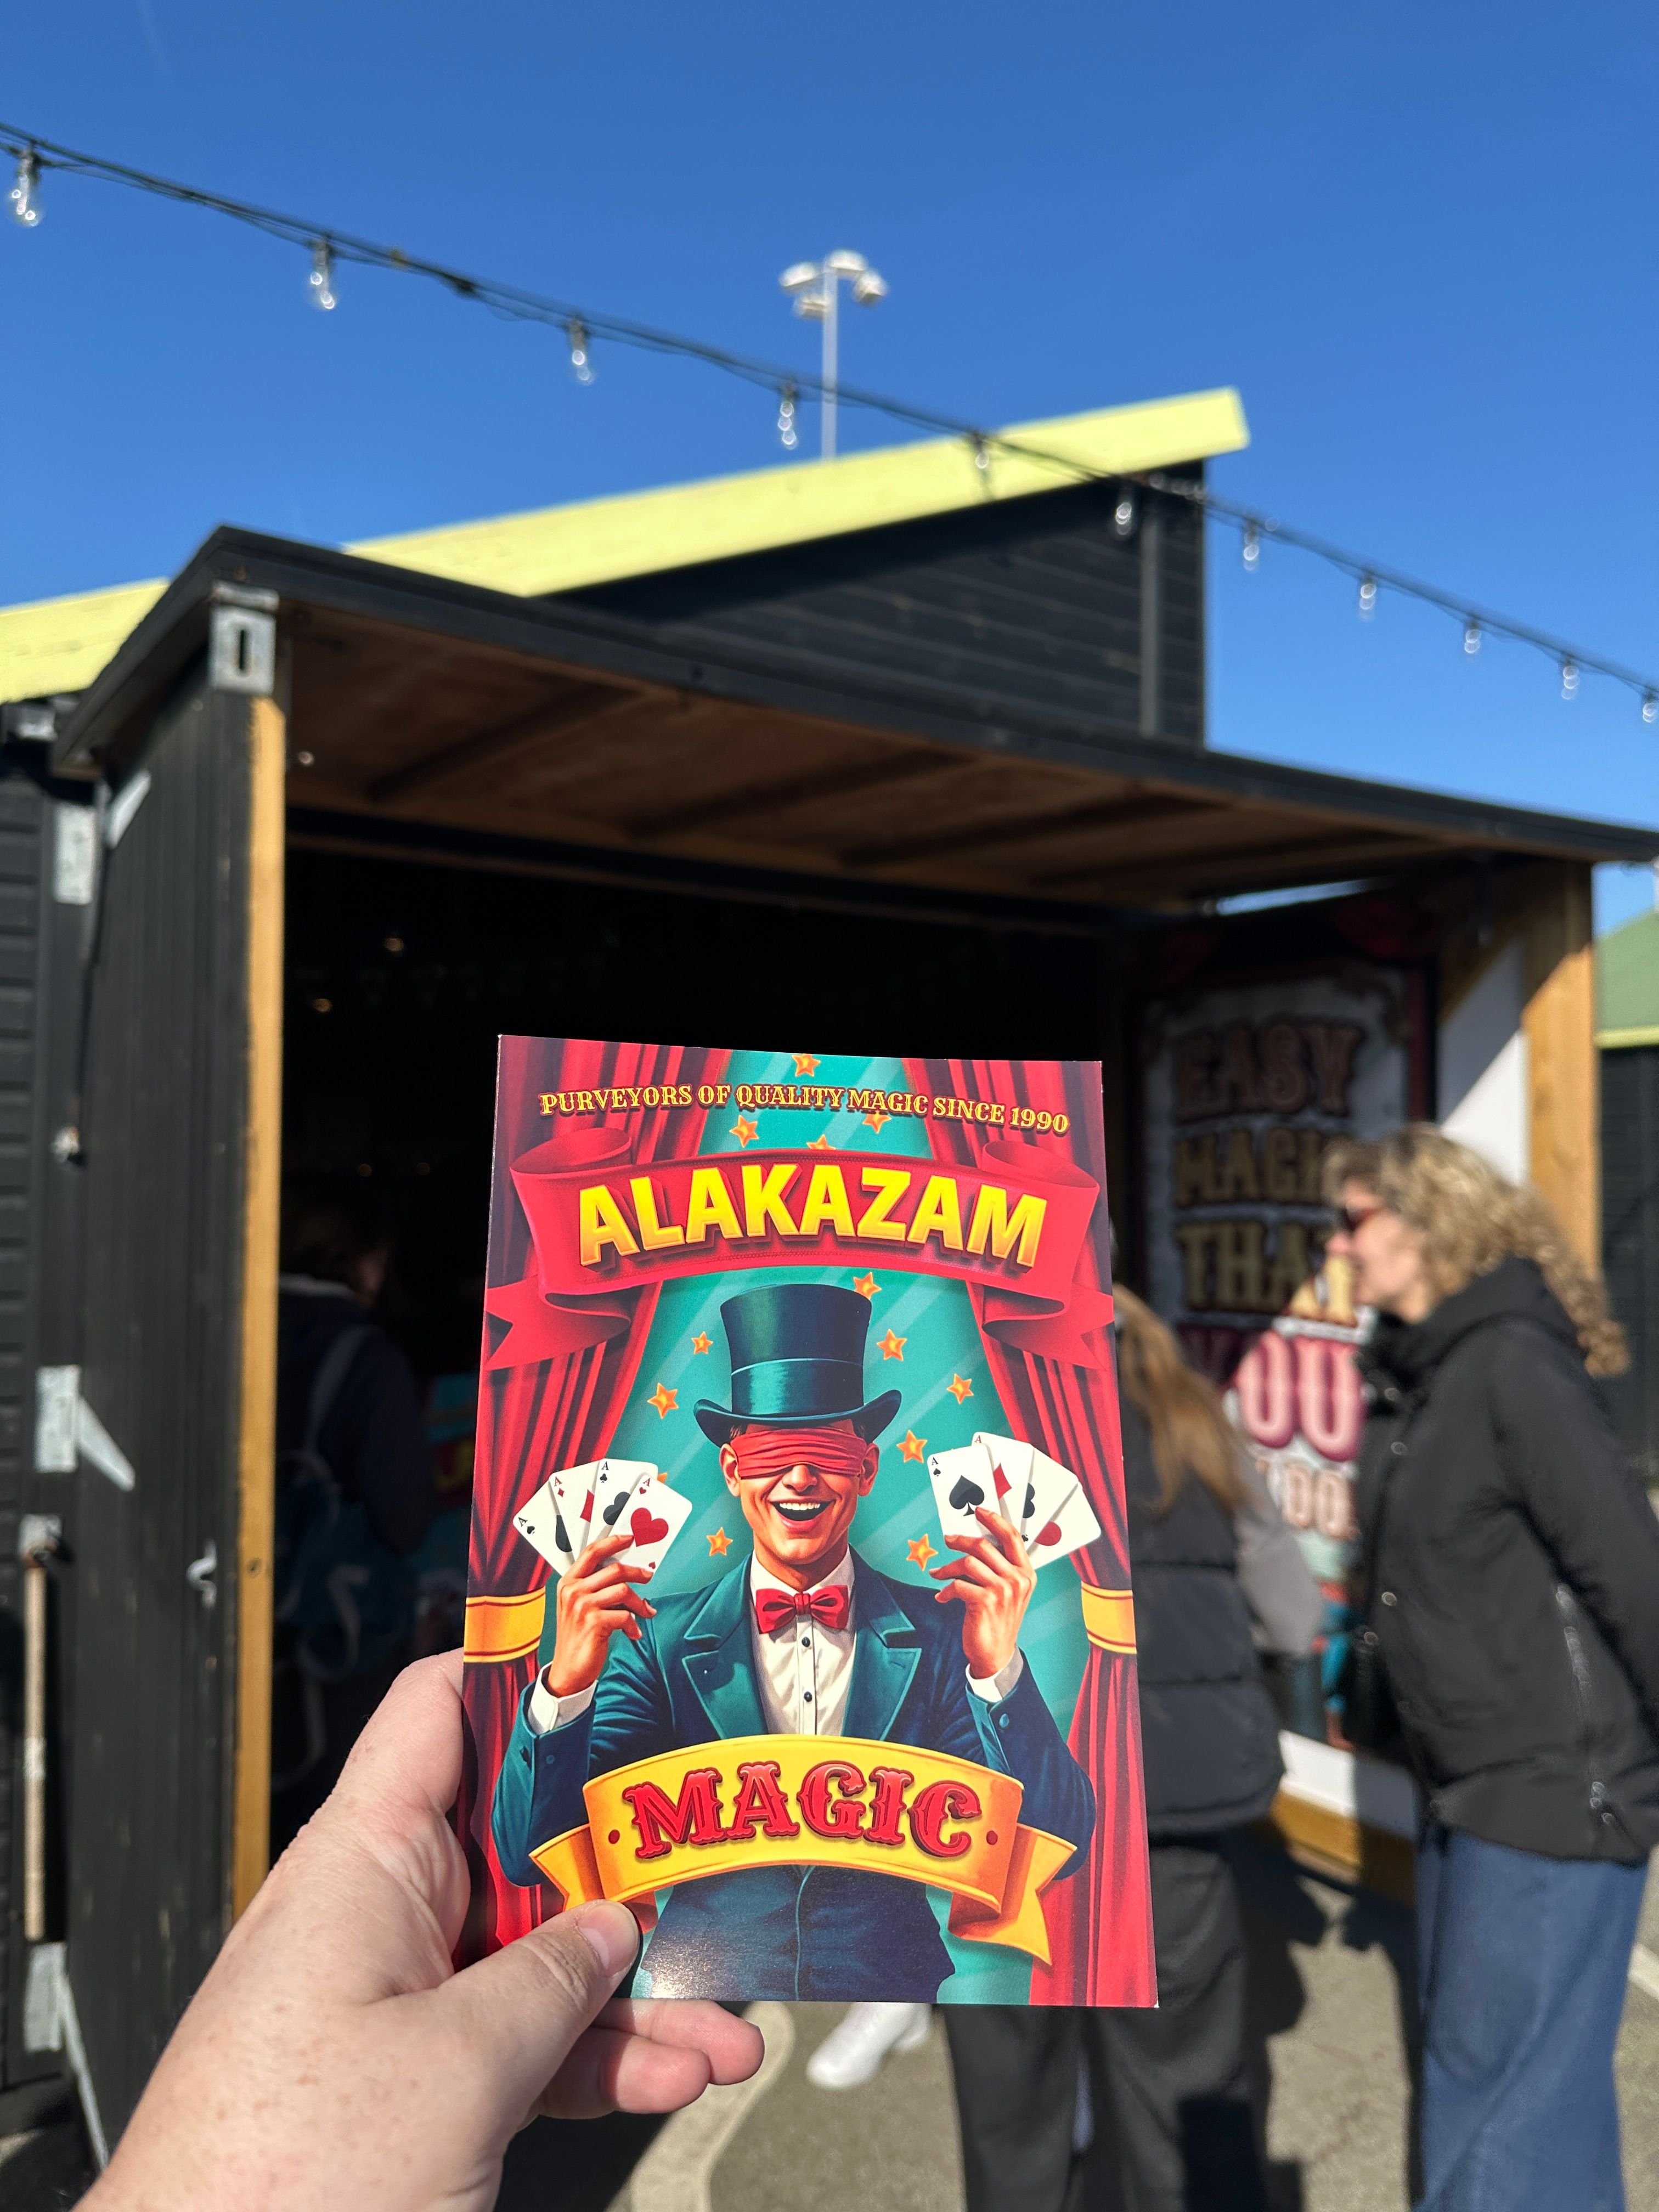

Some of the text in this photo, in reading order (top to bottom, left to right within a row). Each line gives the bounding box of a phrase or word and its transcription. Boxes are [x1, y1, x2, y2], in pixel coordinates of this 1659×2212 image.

[1176, 1020, 1366, 1124] EASY
[539, 1084, 1069, 1133] PURVEYORS OF QUALITY MAGIC SINCE 1990
[1175, 1127, 1323, 1209] MAGI
[579, 1163, 1047, 1268] ALAKAZAM
[601, 1460, 610, 1471] A
[931, 1457, 939, 1466] A
[554, 1476, 562, 1486] A
[642, 1477, 651, 1487] A
[518, 1516, 528, 1527] A
[621, 1759, 984, 1860] MAGIC
